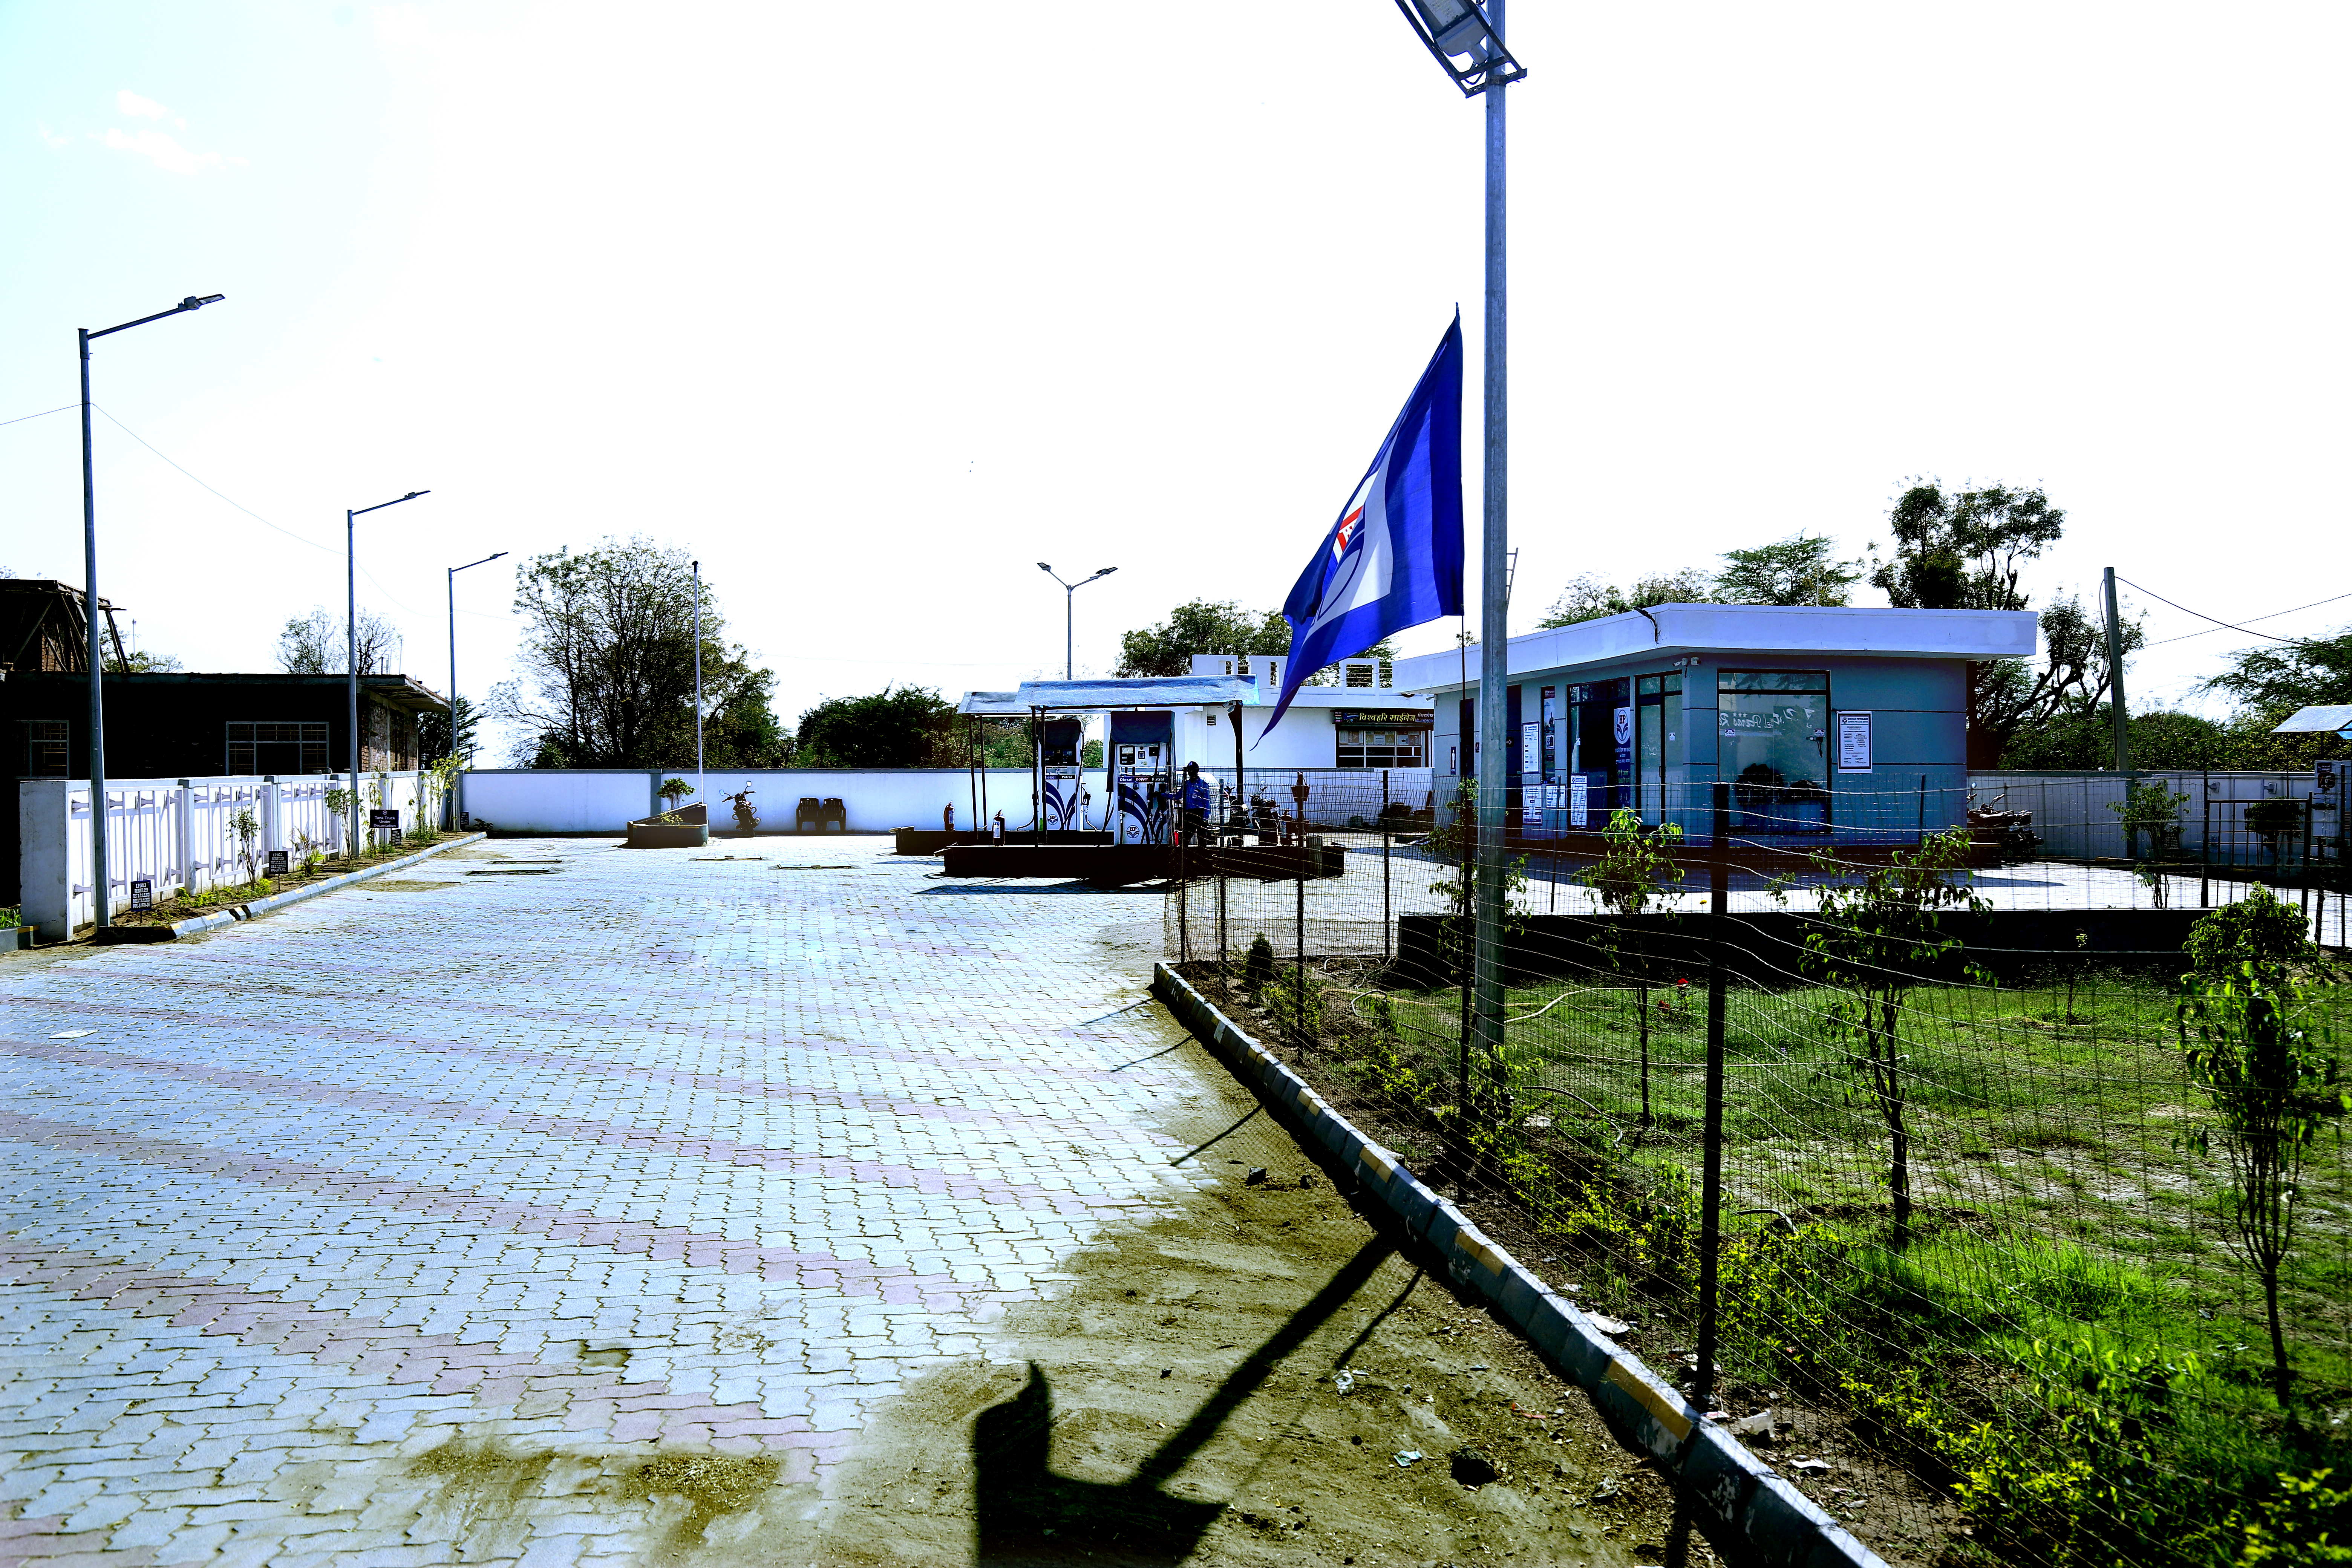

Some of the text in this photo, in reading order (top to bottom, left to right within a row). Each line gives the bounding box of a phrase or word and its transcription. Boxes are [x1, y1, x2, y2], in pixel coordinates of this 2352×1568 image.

[1359, 713, 1387, 722] विश्वहरि
[1390, 712, 1416, 722] साईनेज
[1619, 714, 1626, 724] HP
